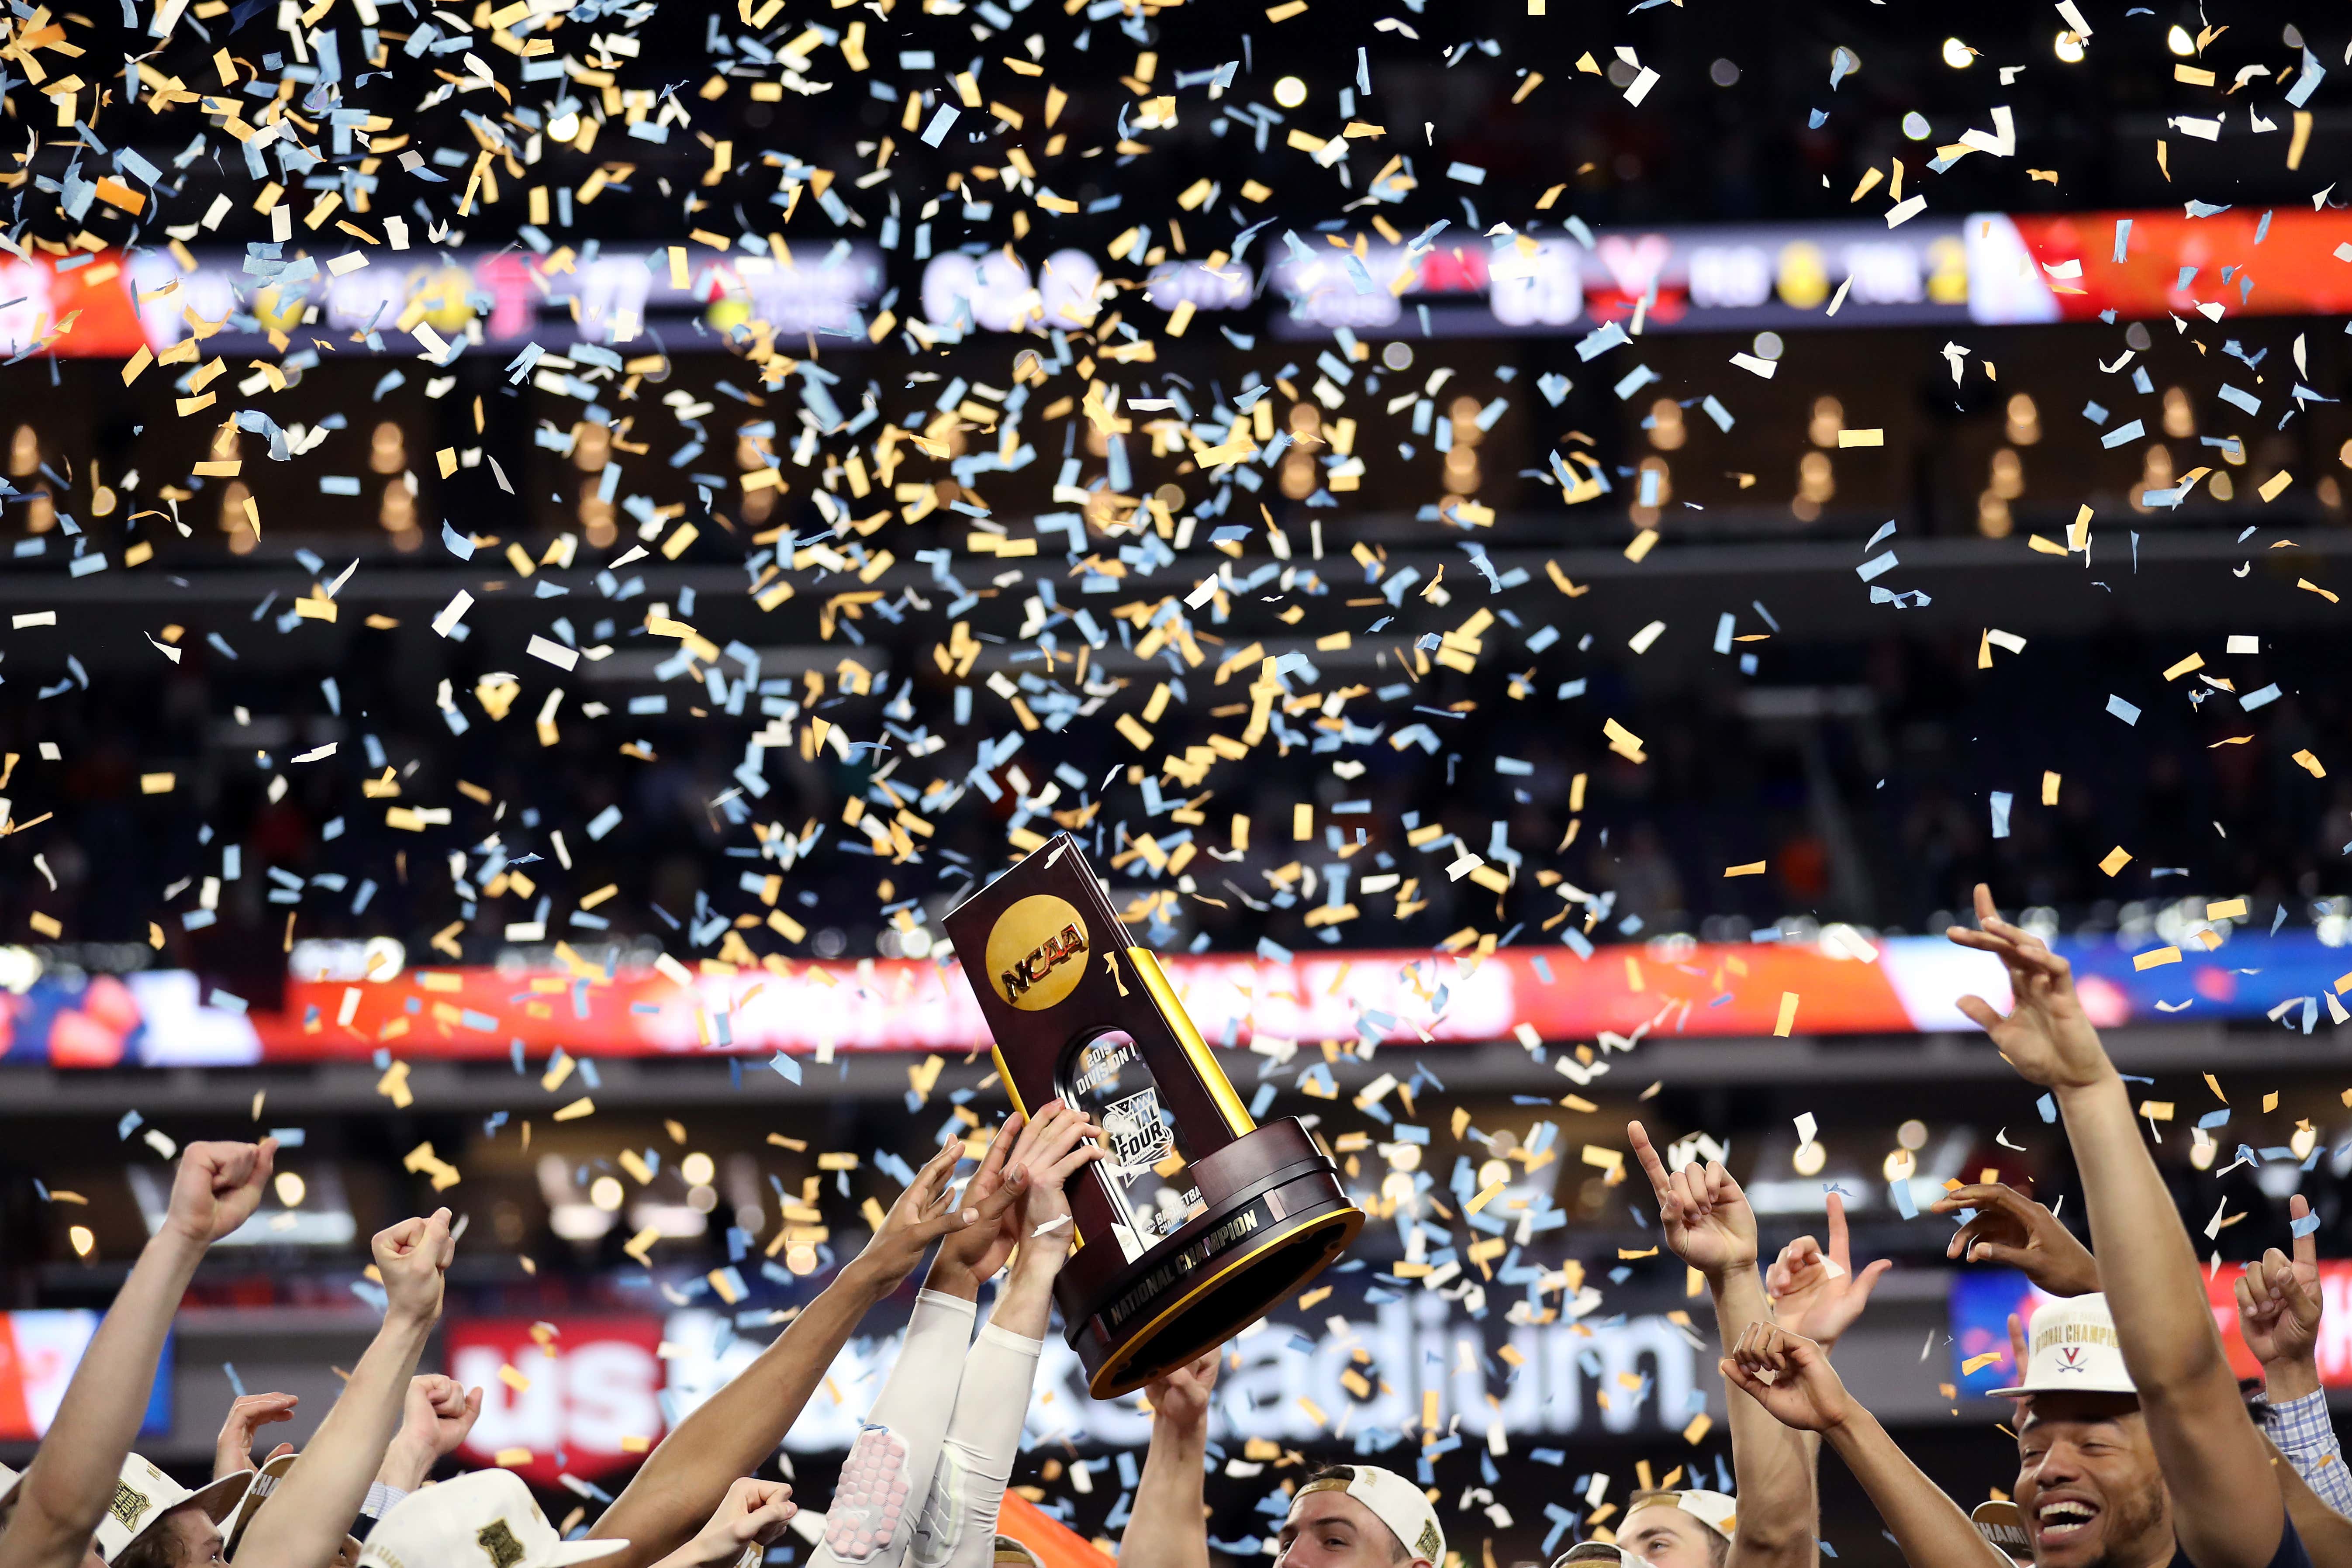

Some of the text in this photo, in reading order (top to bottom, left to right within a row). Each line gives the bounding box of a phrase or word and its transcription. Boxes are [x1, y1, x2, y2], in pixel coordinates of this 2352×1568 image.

[1002, 922, 1088, 1004] NCAA
[1076, 1046, 1129, 1095] DIVISION
[1085, 1041, 1112, 1068] 2019
[1120, 1121, 1163, 1163] FOUR
[1124, 1147, 1152, 1167] MINNEAPOLIS
[1111, 1209, 1259, 1326] NATIONAL CHAMPION
